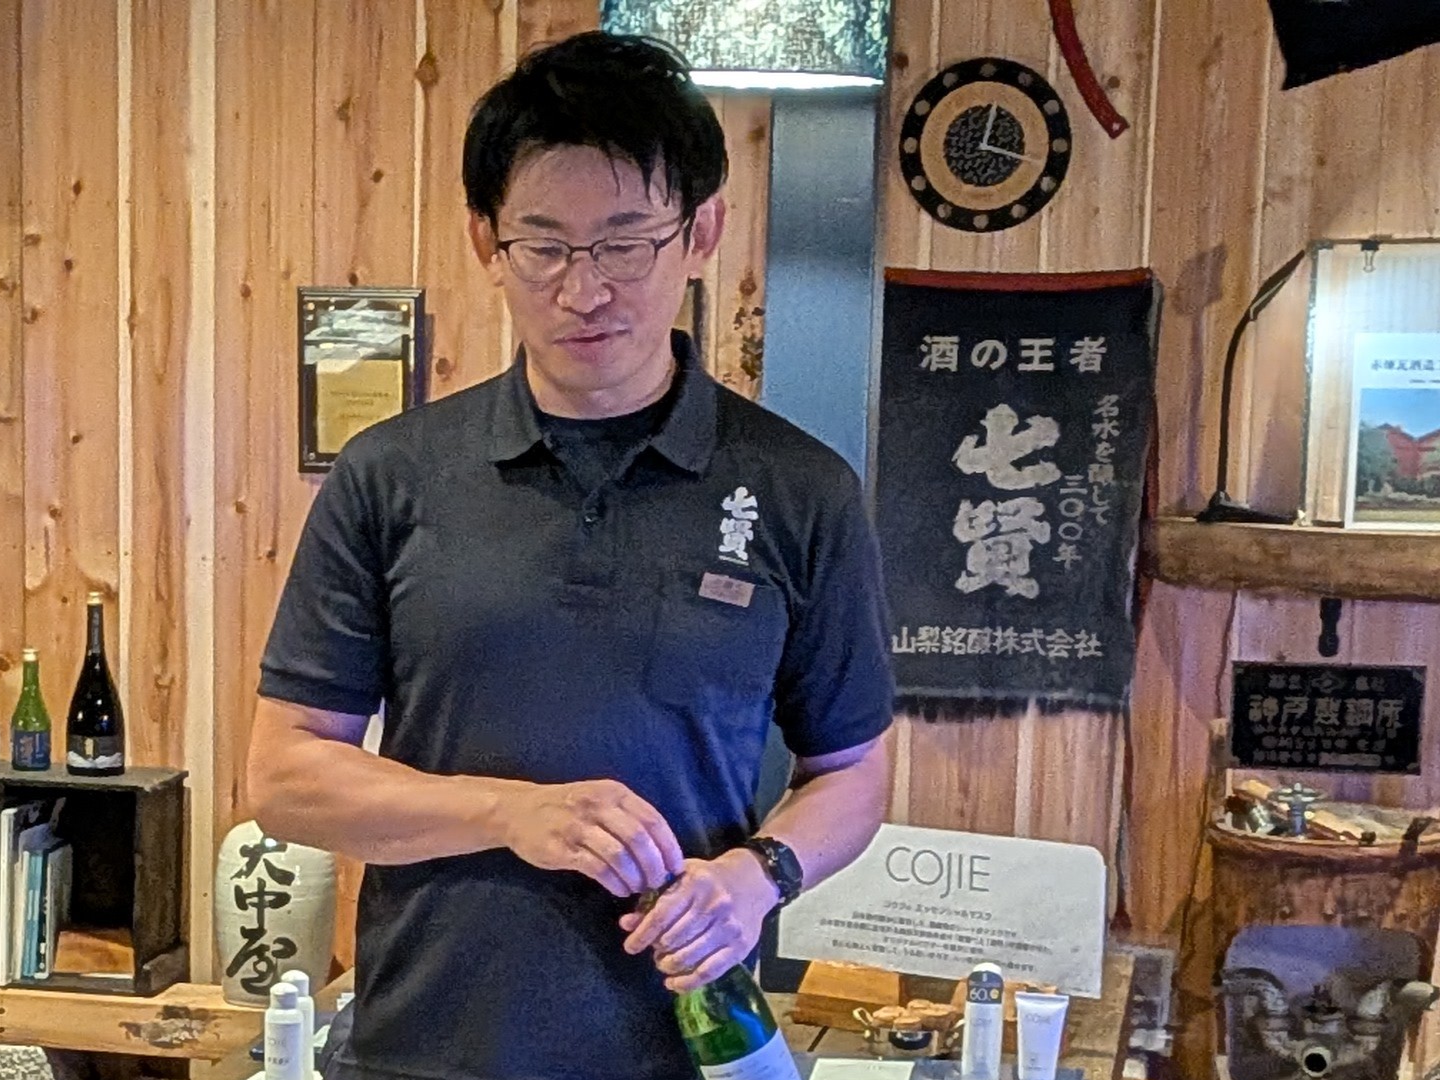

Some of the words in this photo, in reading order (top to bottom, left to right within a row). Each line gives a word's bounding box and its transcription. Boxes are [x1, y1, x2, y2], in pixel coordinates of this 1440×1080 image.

[919, 334, 1108, 373] 酒の王者
[718, 486, 760, 561] 七賢
[952, 403, 1062, 599] 七賢
[891, 625, 1104, 659] 山梨銘醸株式会社
[885, 845, 991, 899] COJIE
